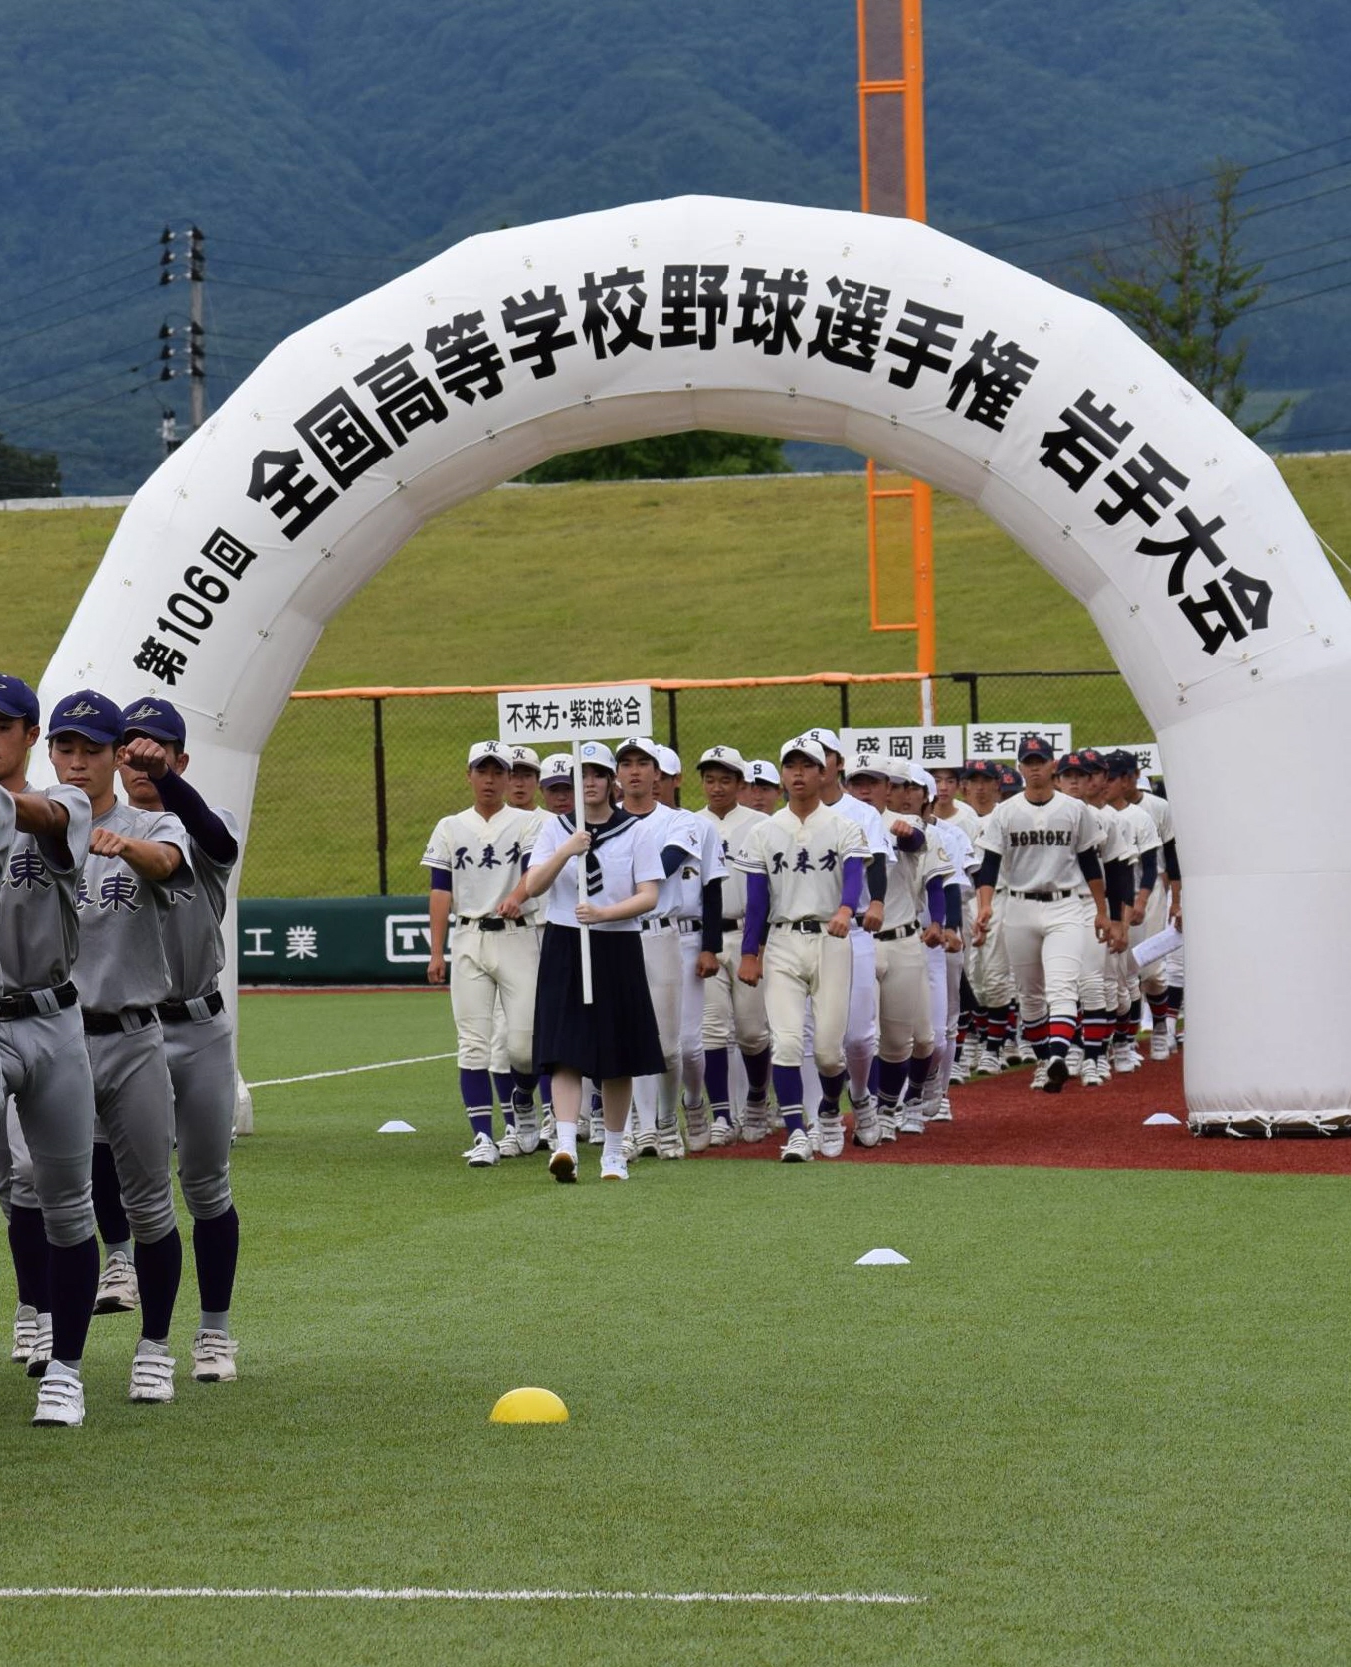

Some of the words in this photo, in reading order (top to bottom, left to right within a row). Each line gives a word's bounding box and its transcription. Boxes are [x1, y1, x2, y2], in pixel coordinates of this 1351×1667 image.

[132, 526, 258, 687] 第106回
[245, 264, 1039, 543] 全国高等学校野球選手権
[1039, 388, 1274, 657] 岩手大会
[483, 741, 500, 753] K
[856, 735, 946, 760] 盛岡農
[512, 748, 526, 760] K
[552, 760, 567, 773] K
[856, 755, 871, 767] K
[753, 764, 763, 775] S
[243, 925, 319, 960] 工業
